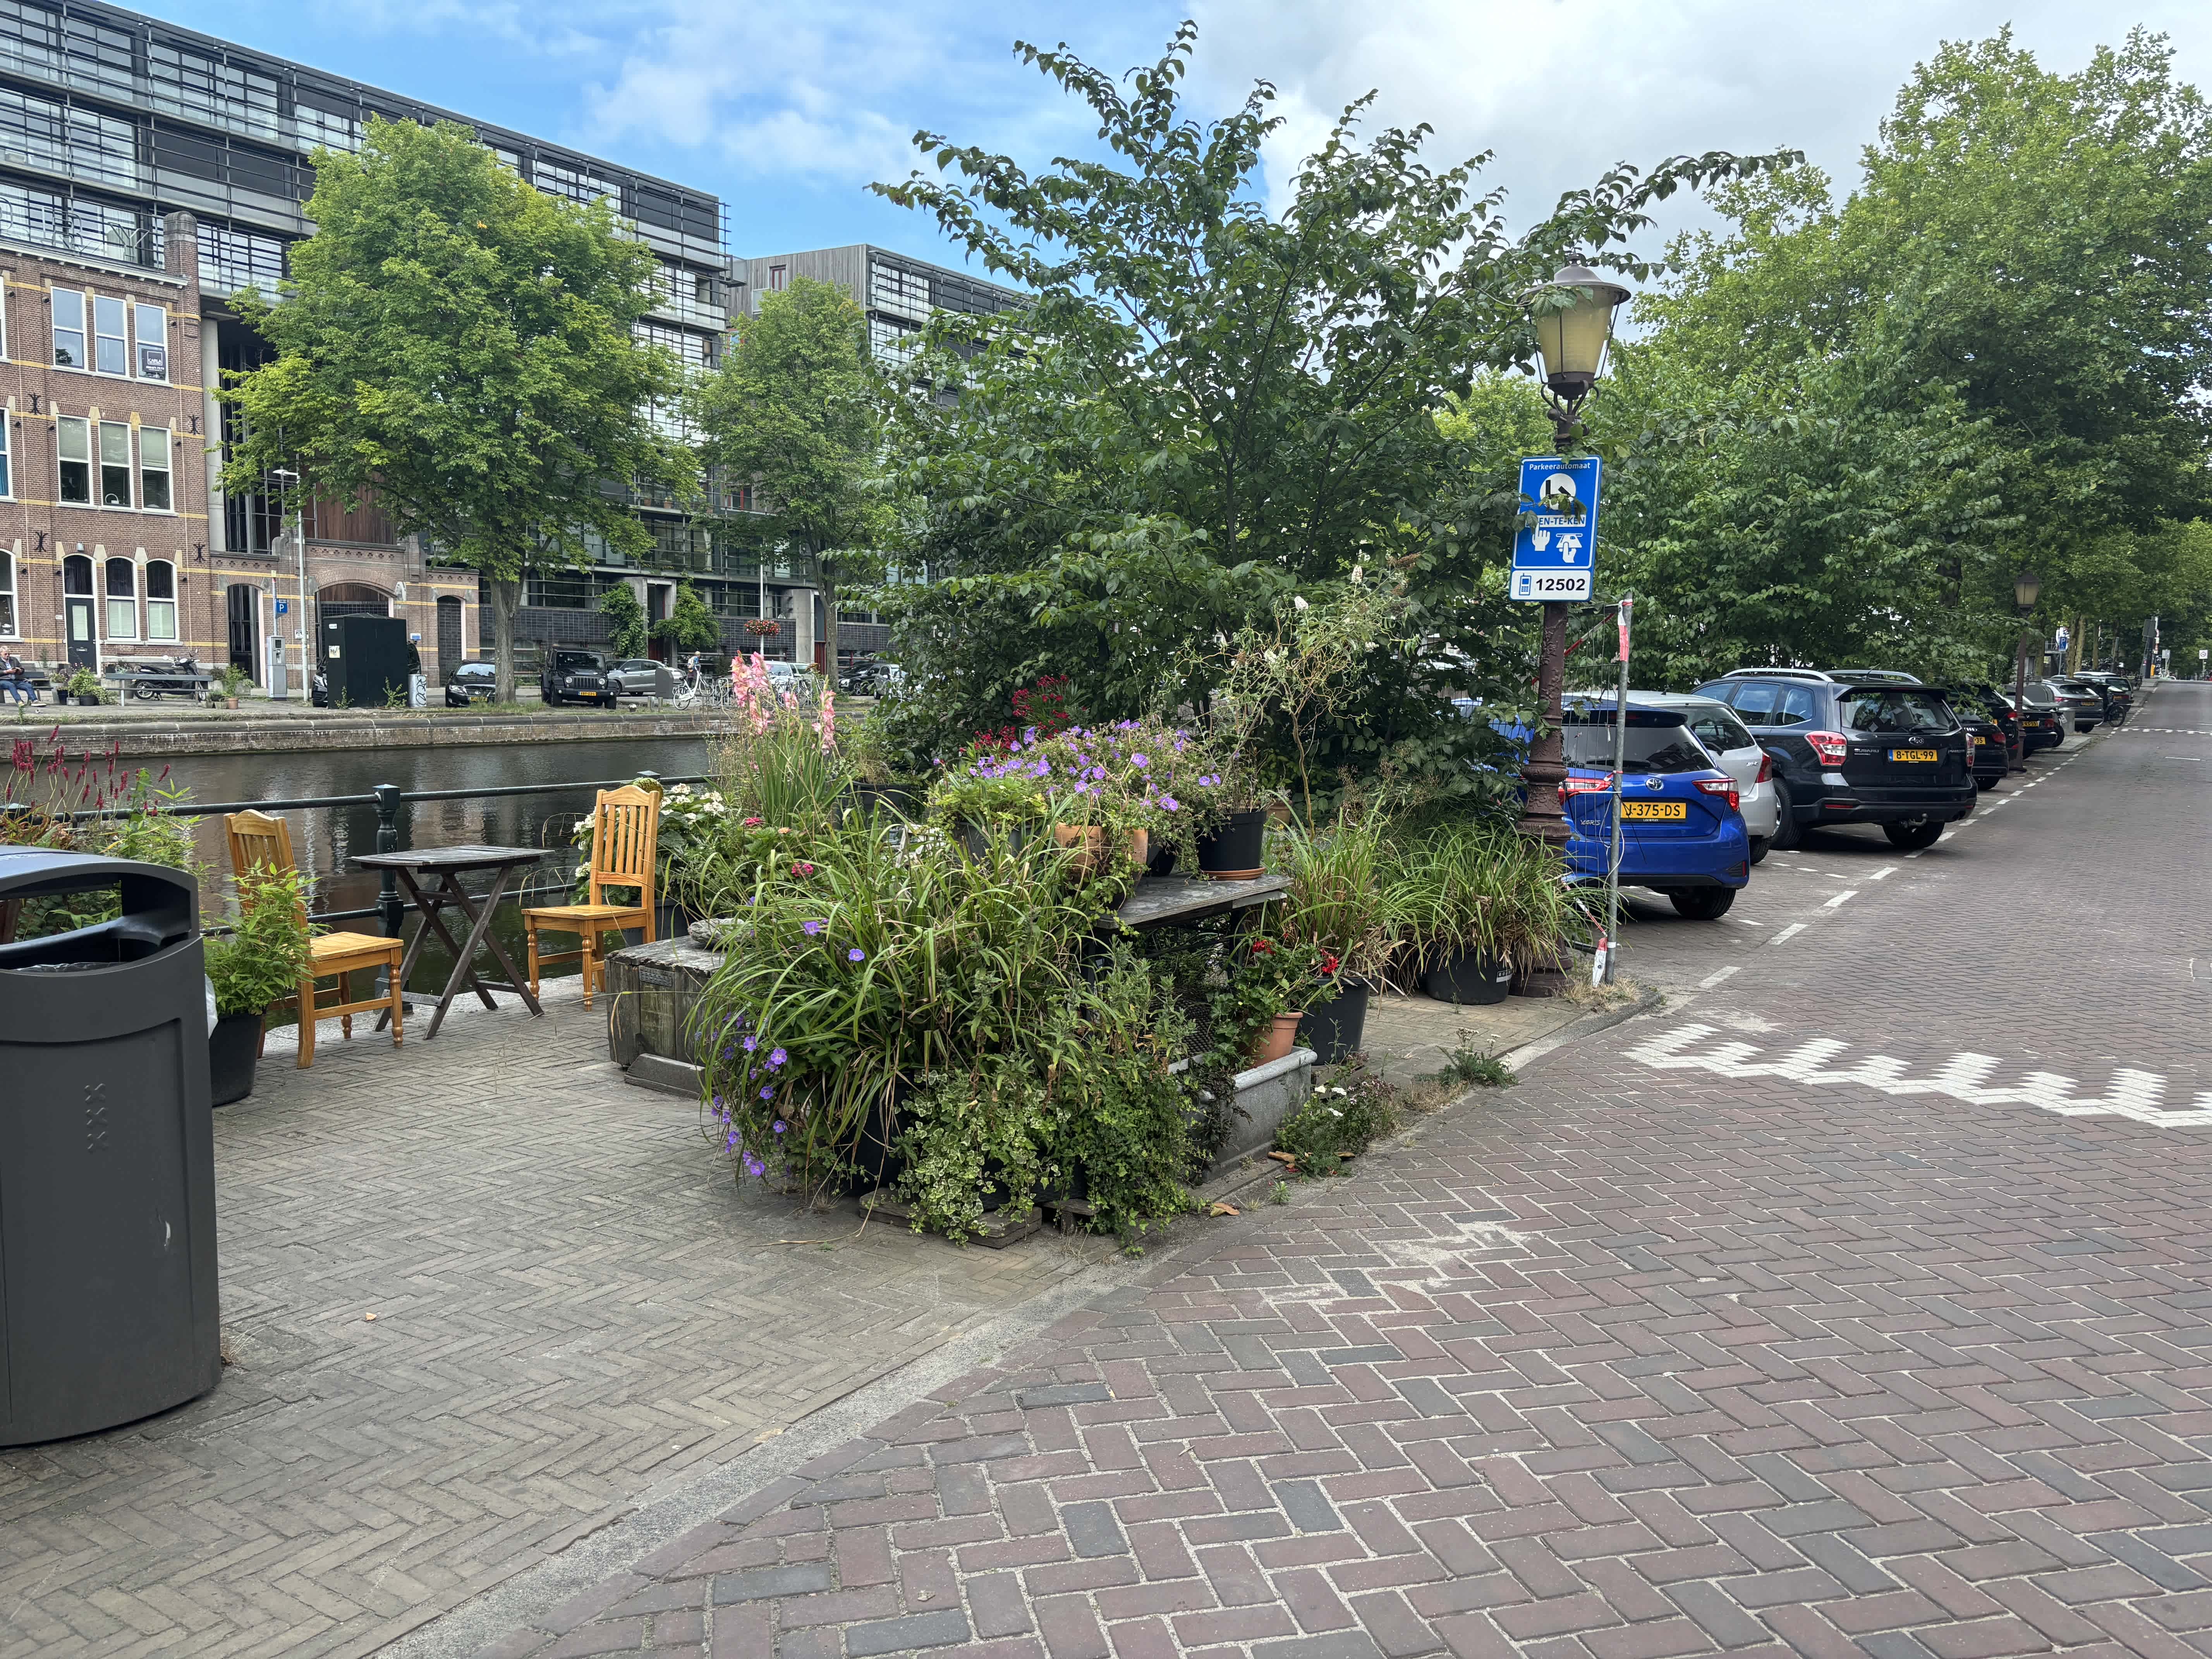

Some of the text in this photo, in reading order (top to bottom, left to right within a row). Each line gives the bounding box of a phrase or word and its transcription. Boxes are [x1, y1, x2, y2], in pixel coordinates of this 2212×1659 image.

[1537, 517, 1585, 525] EN-TE-KEN
[1536, 578, 1585, 591] 12502
[280, 604, 284, 612] P
[1896, 750, 1934, 759] 8-TGL-99
[1626, 804, 1680, 816] J-375-DS
